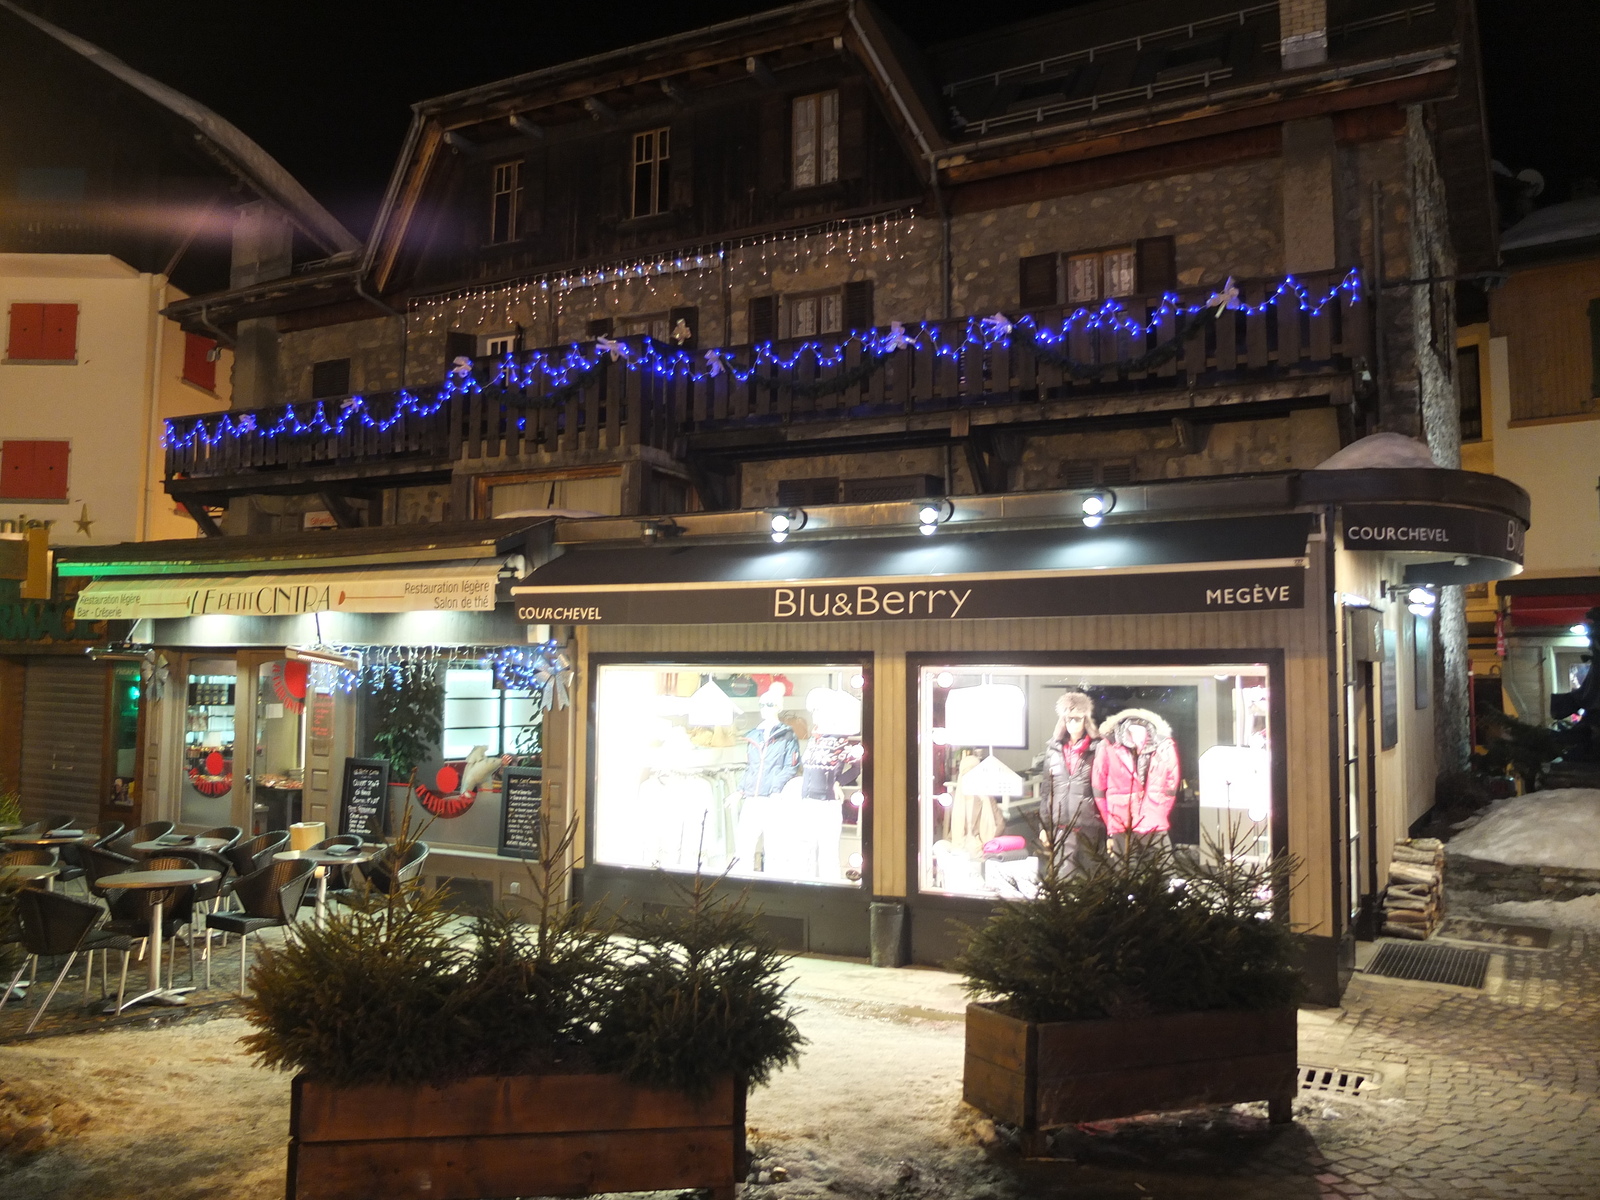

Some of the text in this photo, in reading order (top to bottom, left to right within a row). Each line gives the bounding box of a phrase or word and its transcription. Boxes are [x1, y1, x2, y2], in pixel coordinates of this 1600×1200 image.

[1348, 526, 1449, 542] COURCHEVEL
[404, 581, 490, 595] Restauration légère
[1206, 584, 1290, 605] MEGÈVE
[191, 589, 216, 614] LE
[256, 584, 330, 614] CINTRA
[433, 595, 489, 609] Salon de thé
[774, 586, 972, 618] Blu&Berry
[77, 607, 90, 617] Bar
[518, 606, 602, 620] COURCHEVEL
